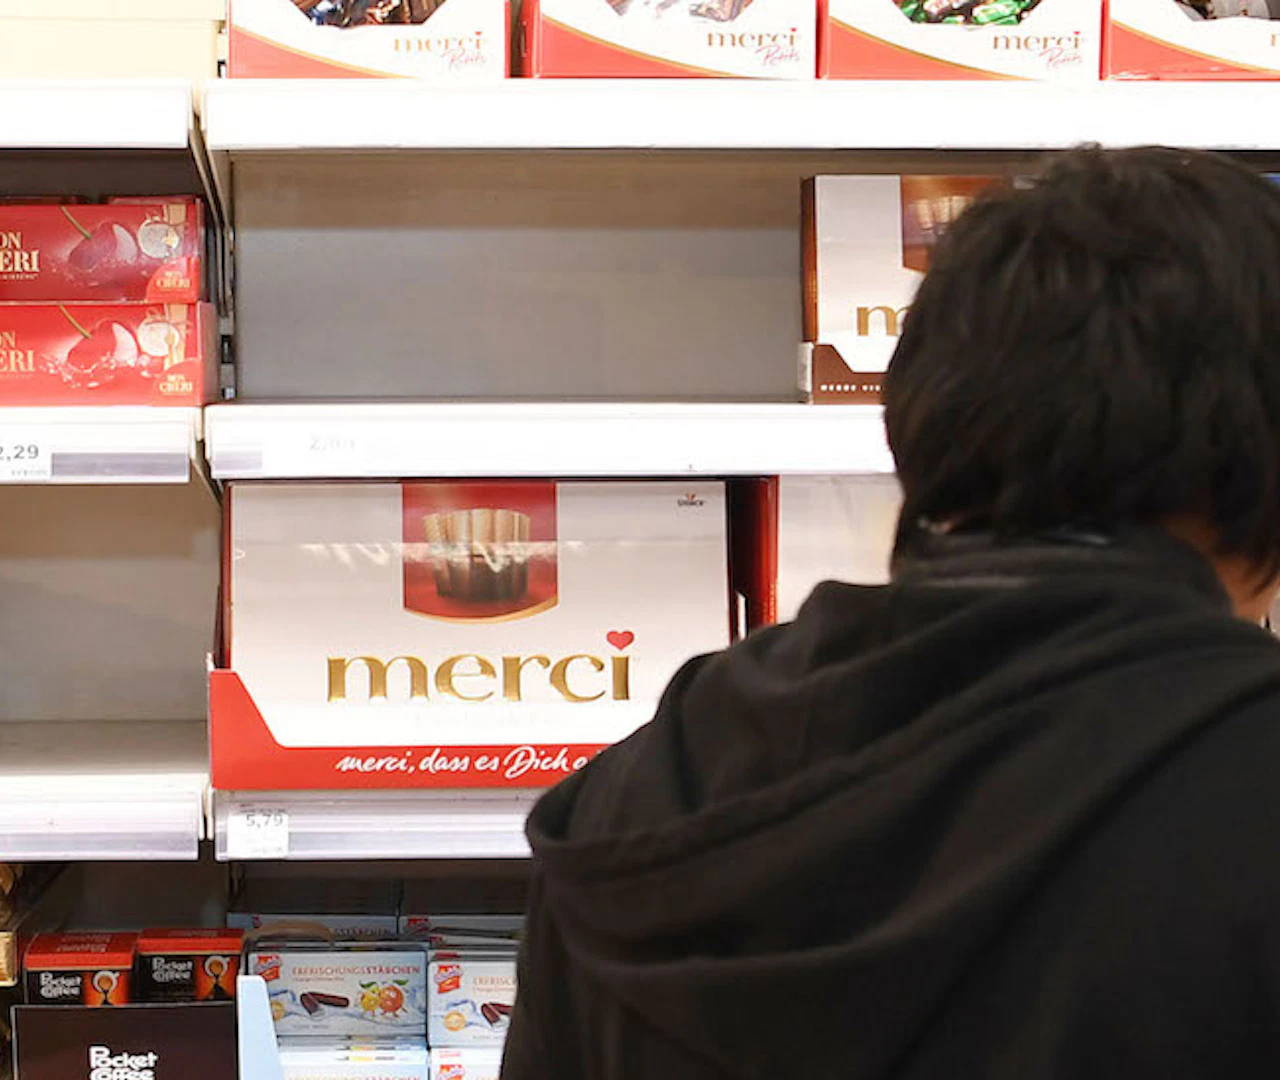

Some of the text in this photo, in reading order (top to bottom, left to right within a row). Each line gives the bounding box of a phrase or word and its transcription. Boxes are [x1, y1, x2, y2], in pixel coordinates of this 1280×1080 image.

[393, 30, 483, 53] merci
[707, 26, 798, 50] merci
[992, 29, 1081, 52] merci
[326, 630, 636, 704] merci
[335, 744, 570, 780] merci, dass es Dich
[245, 812, 284, 829] 5,79
[151, 955, 194, 972] Pocket
[39, 971, 82, 988] Pocket
[151, 969, 192, 984] Coffee
[38, 984, 82, 999] Coffee
[88, 1044, 158, 1069] Pocket
